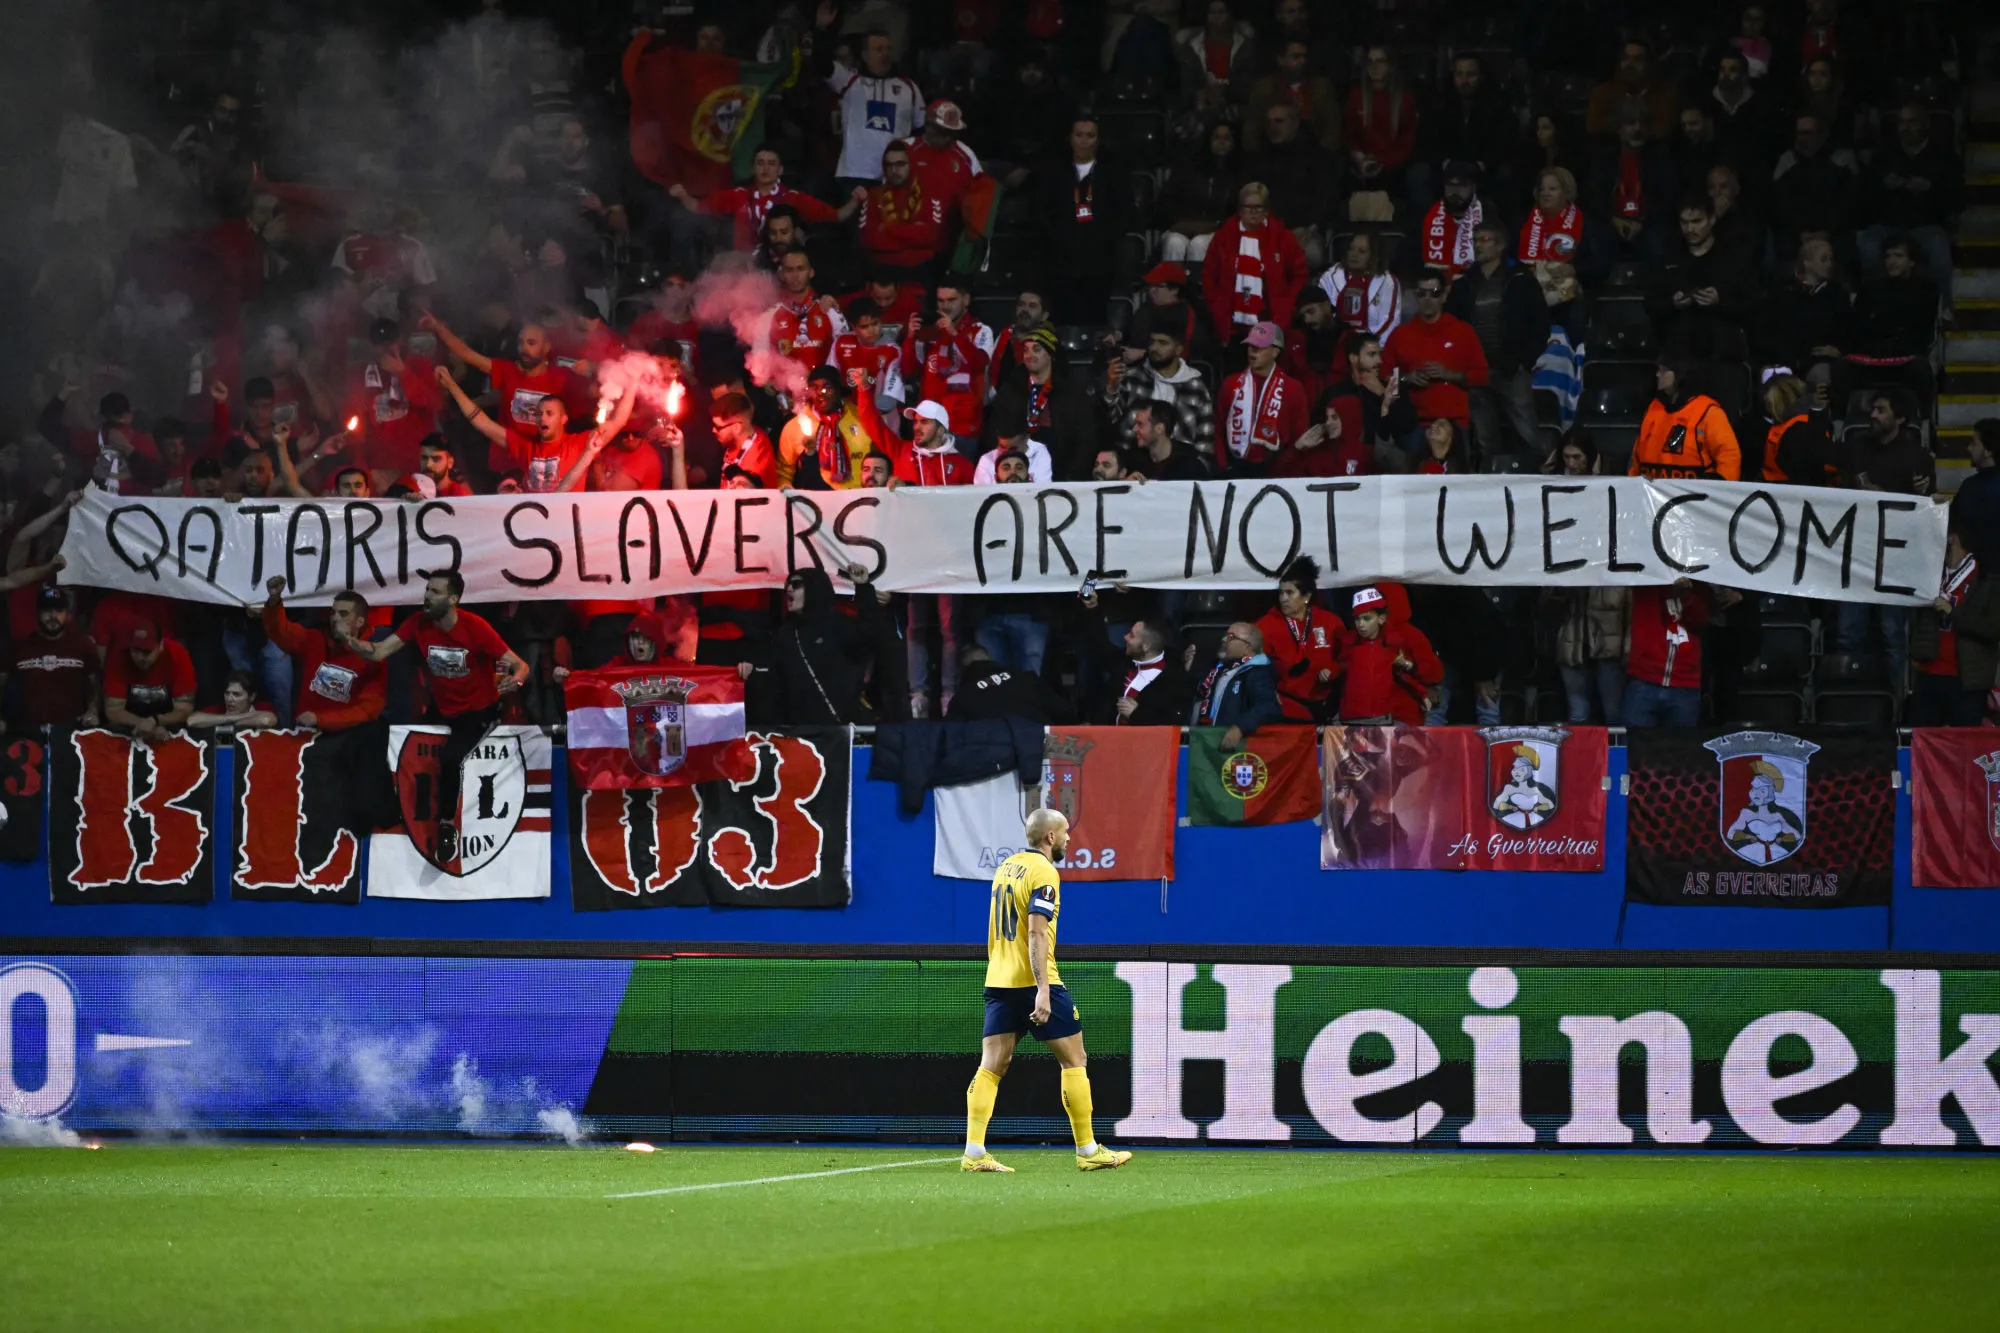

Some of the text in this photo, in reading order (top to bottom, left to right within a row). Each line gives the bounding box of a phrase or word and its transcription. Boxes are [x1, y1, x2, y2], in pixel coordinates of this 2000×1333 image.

[106, 482, 1917, 597] QATARIS SLAVERS ARE NOT WELCOME
[1447, 832, 1479, 857] As
[992, 883, 1018, 942] 10
[1682, 871, 1711, 895] AS
[1113, 962, 2000, 1146] Heinek
